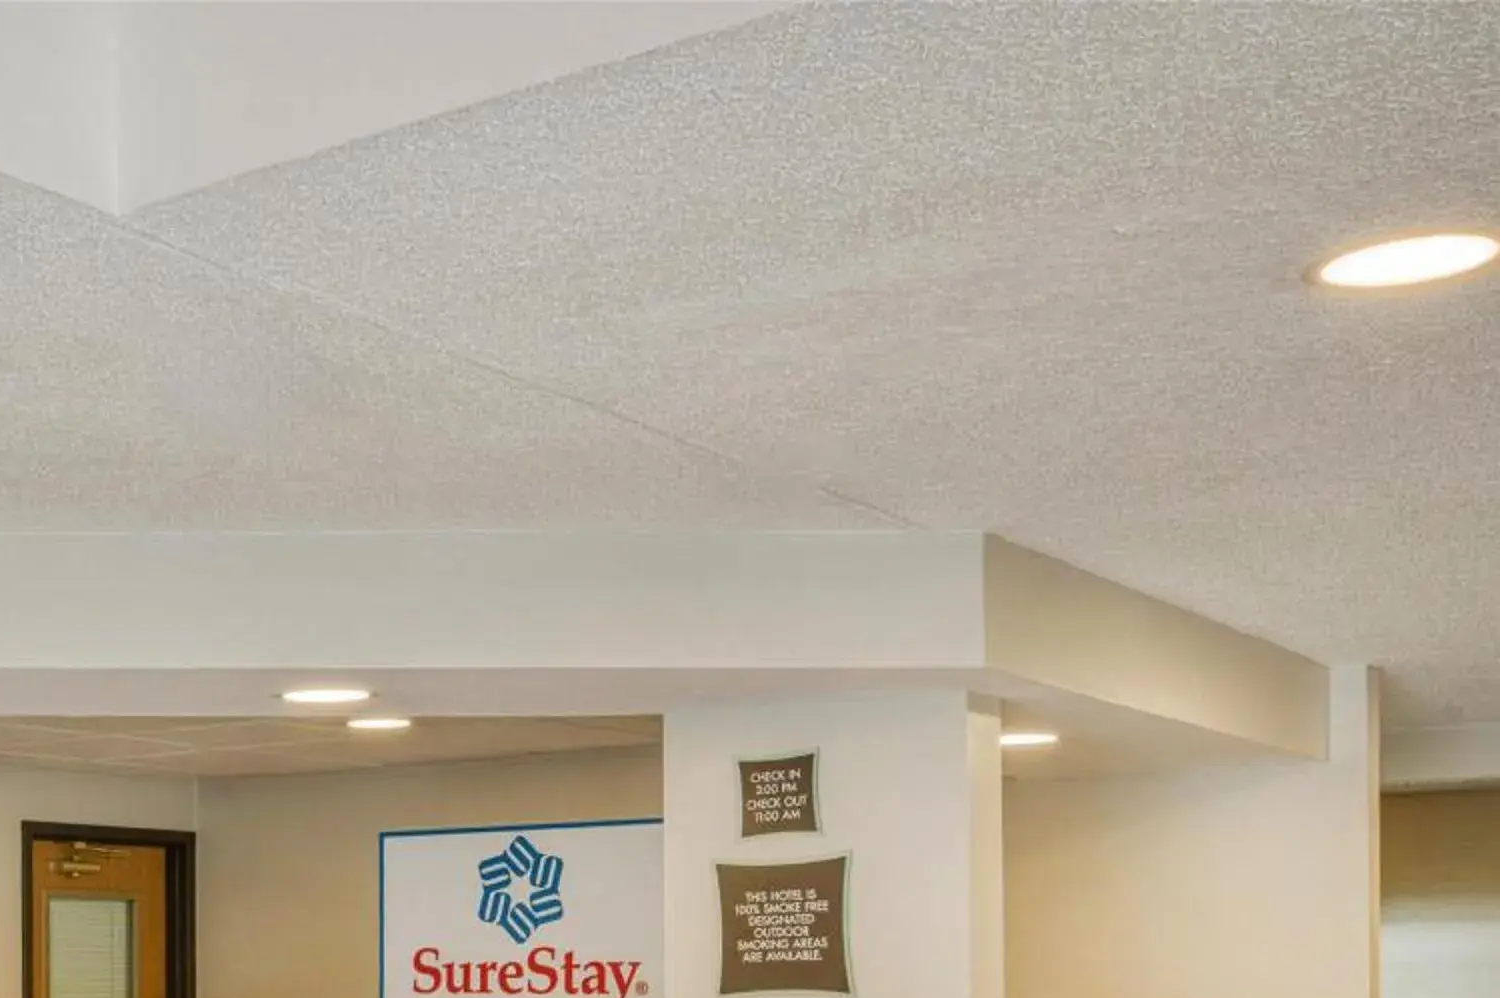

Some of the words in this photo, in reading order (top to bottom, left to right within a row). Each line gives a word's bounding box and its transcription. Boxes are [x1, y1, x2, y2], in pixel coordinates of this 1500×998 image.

[750, 770, 785, 783] CHECK
[747, 797, 781, 811] CHECK
[783, 795, 808, 807] OUT
[781, 809, 801, 821] AM
[770, 889, 803, 901] HOTEL
[763, 902, 801, 913] SMOKE
[804, 900, 829, 912] FREE
[747, 914, 815, 926] DESIGNATED
[753, 926, 809, 938] OUTDOOR
[737, 939, 790, 951] SMOKING
[792, 937, 828, 949] AREAS
